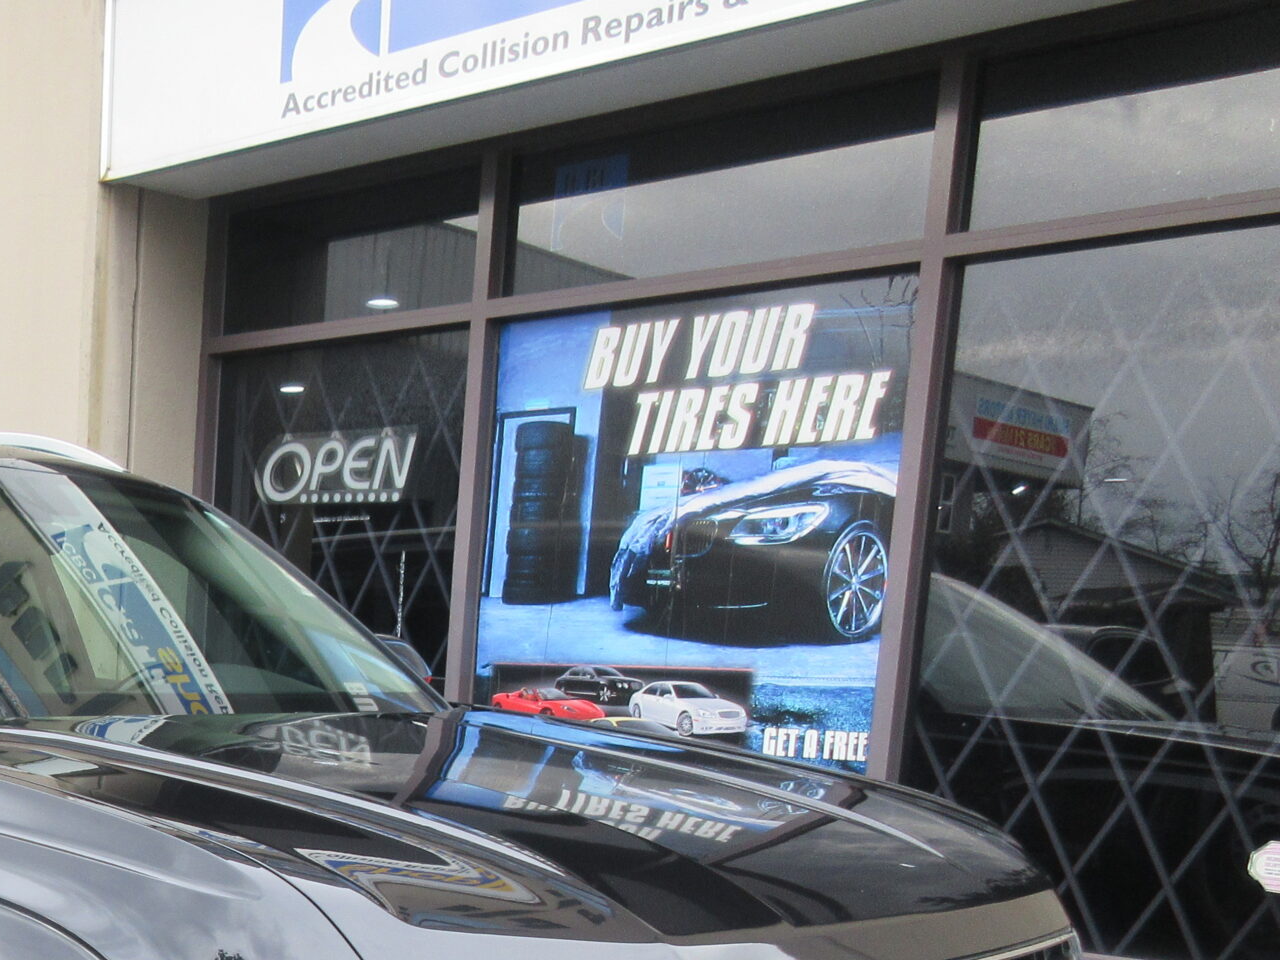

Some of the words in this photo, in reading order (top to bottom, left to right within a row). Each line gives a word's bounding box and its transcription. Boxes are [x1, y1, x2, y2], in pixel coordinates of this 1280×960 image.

[280, 59, 428, 119] Accredited
[437, 29, 570, 79] Collision
[580, 0, 710, 43] Repairs
[583, 317, 681, 390] BUY
[684, 303, 816, 381] YOUR
[627, 382, 760, 457] TIRES
[761, 369, 893, 447] HERE
[262, 432, 418, 502] OPEN
[762, 727, 800, 758] GET
[802, 728, 819, 759] A
[822, 730, 869, 762] FREE
